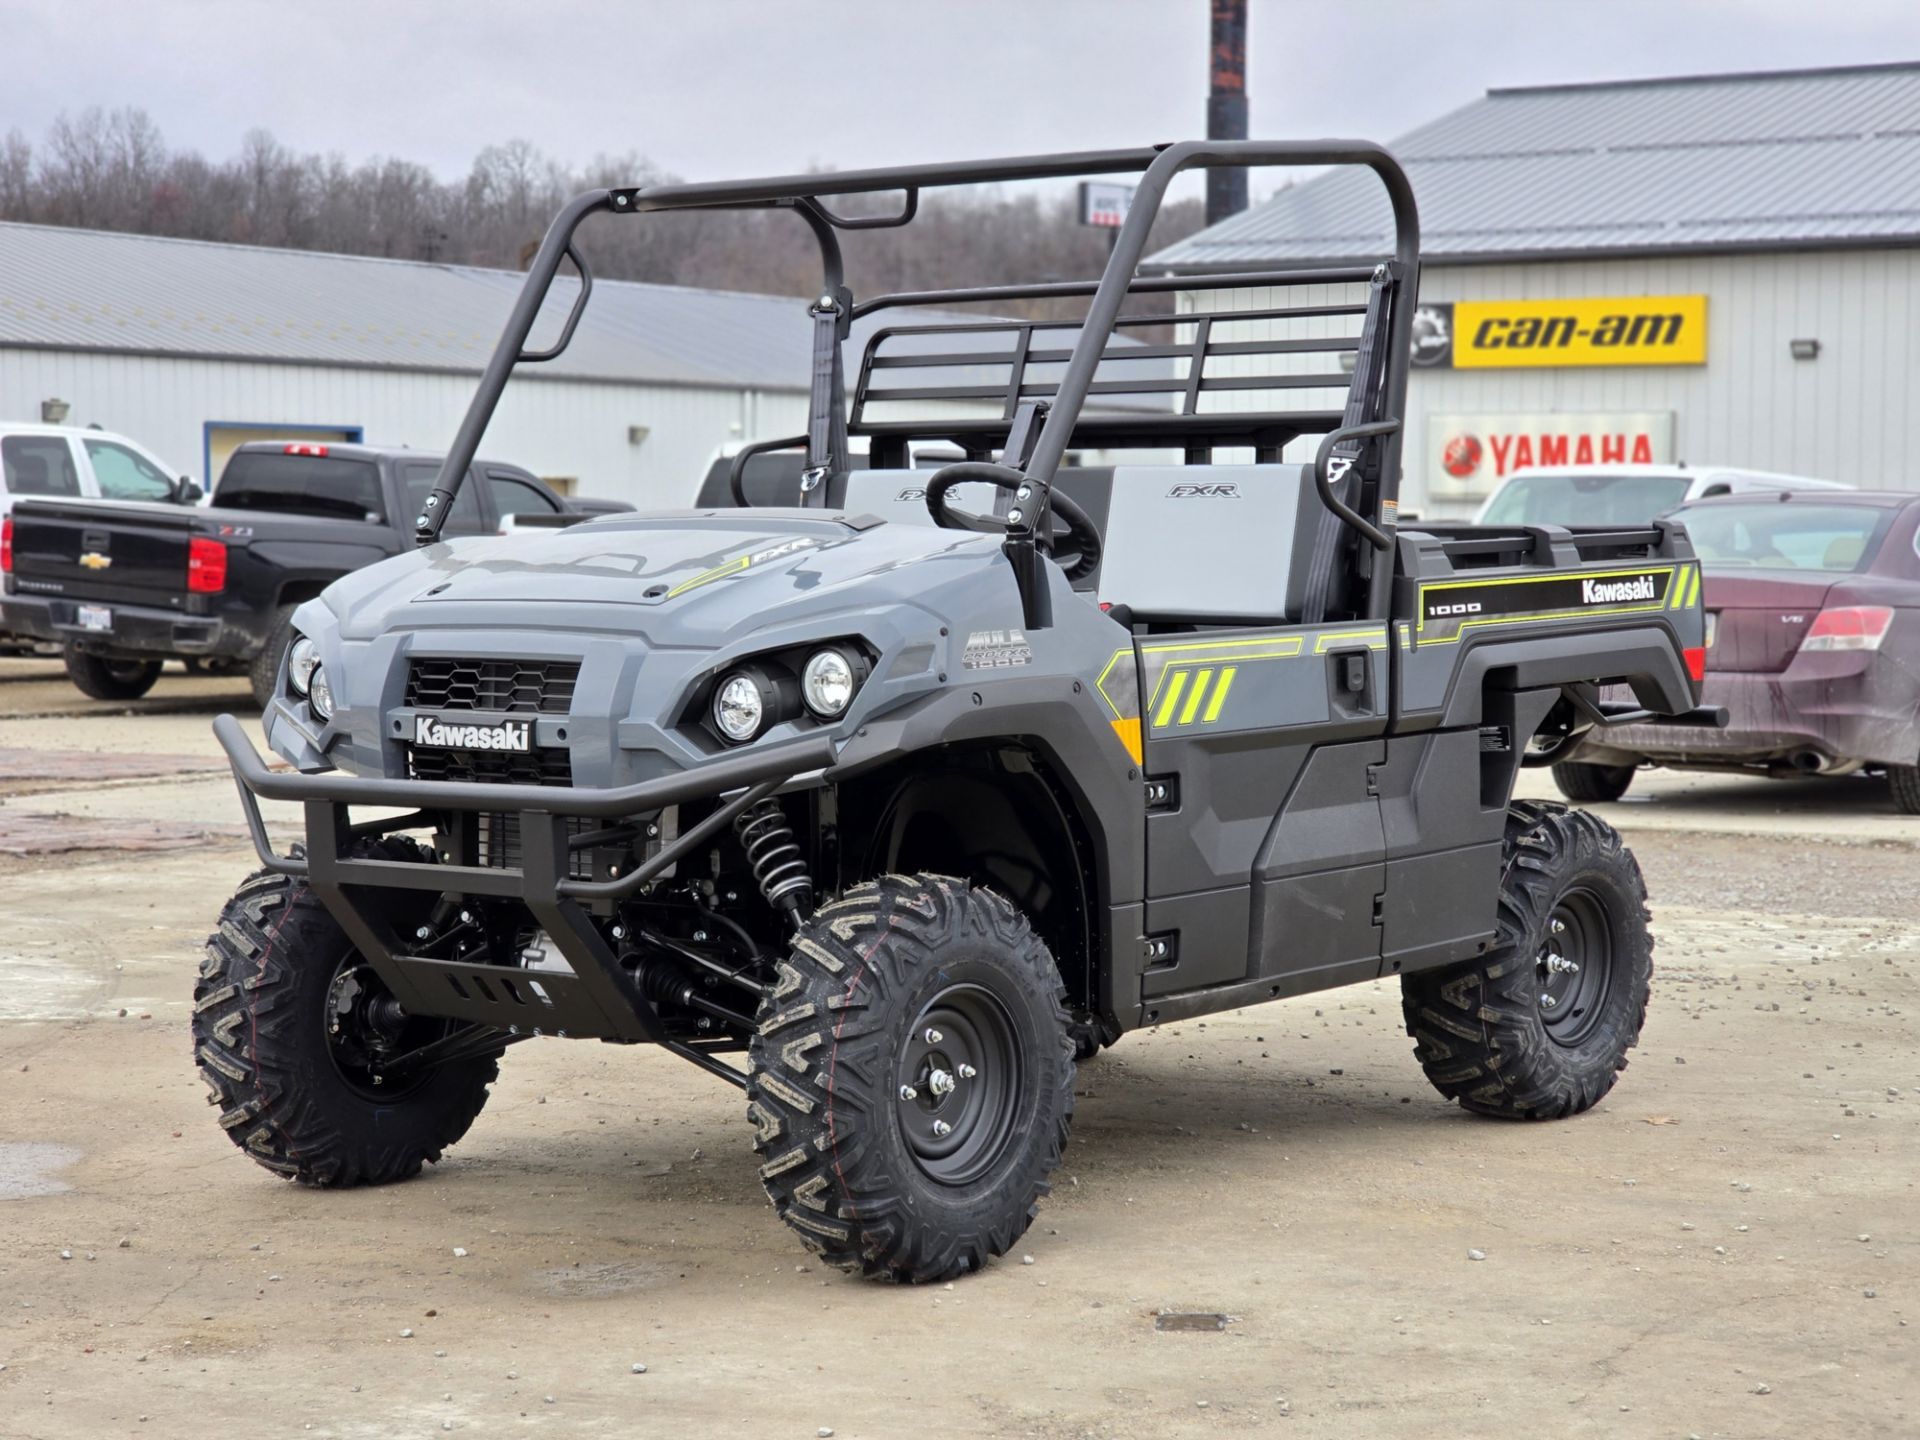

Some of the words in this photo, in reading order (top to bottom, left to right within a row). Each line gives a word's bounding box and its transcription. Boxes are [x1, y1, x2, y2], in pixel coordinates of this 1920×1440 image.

[1472, 313, 1684, 349] can-am
[1489, 433, 1652, 476] YAMAHA
[1167, 483, 1239, 499] FXR
[1582, 576, 1654, 604] Kawasaki
[1429, 602, 1481, 615] 1000
[1781, 615, 1803, 623] V6
[416, 717, 529, 750] Kawasaki
